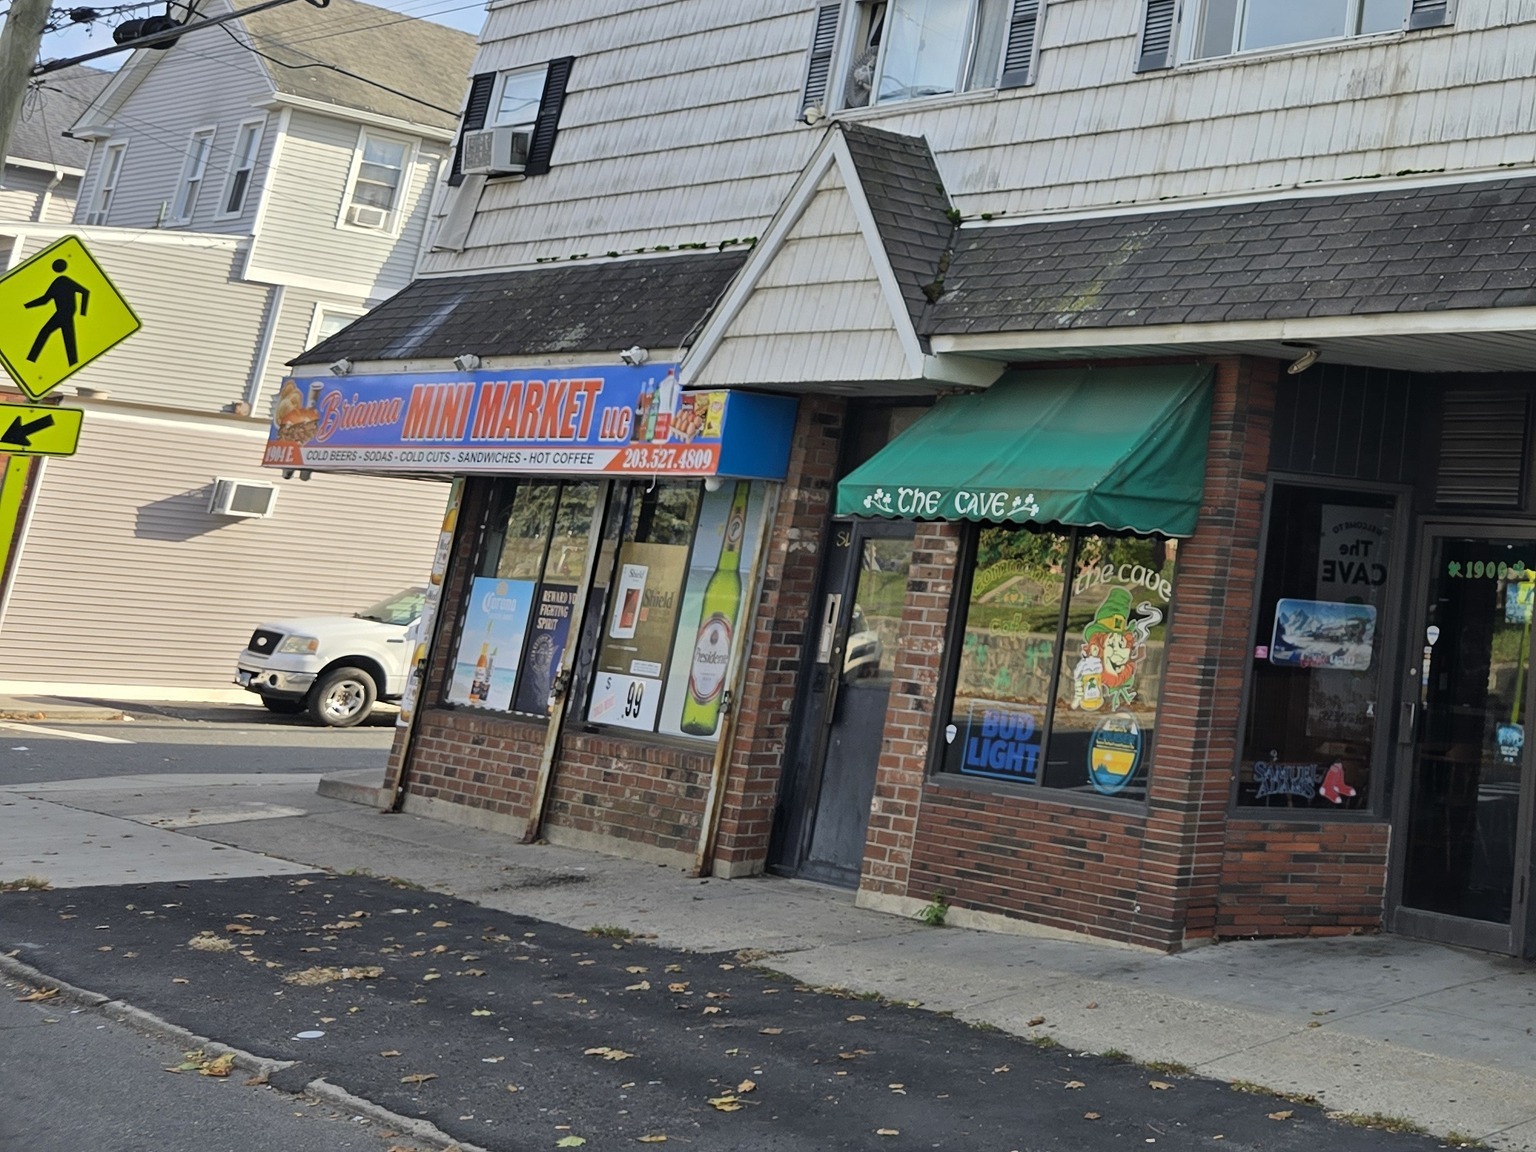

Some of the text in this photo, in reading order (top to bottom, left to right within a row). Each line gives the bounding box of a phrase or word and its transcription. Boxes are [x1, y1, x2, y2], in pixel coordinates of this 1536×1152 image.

[316, 377, 632, 443] Brianna MINI MARKET LLC
[306, 450, 329, 461] COLD
[330, 450, 357, 461] BEERS
[363, 450, 393, 462] SODAS
[400, 451, 424, 462] COLD
[426, 451, 451, 462] CUTS
[457, 451, 521, 464] SANDWICHES
[529, 452, 550, 464] HOT
[553, 452, 594, 465] COFFEE
[622, 448, 713, 469] 203.527.4809
[954, 491, 1008, 516] CAVE
[1466, 560, 1507, 579] 1900
[1073, 563, 1171, 602] the cave
[542, 590, 577, 605] REWARD YO
[540, 603, 569, 618] FIGHTING
[536, 617, 559, 631] SPIRIT
[982, 709, 1035, 742] BUD
[967, 737, 1041, 774] LIGHT
[1254, 761, 1318, 782] SAMUEL
[1255, 779, 1315, 799] ADAMS
